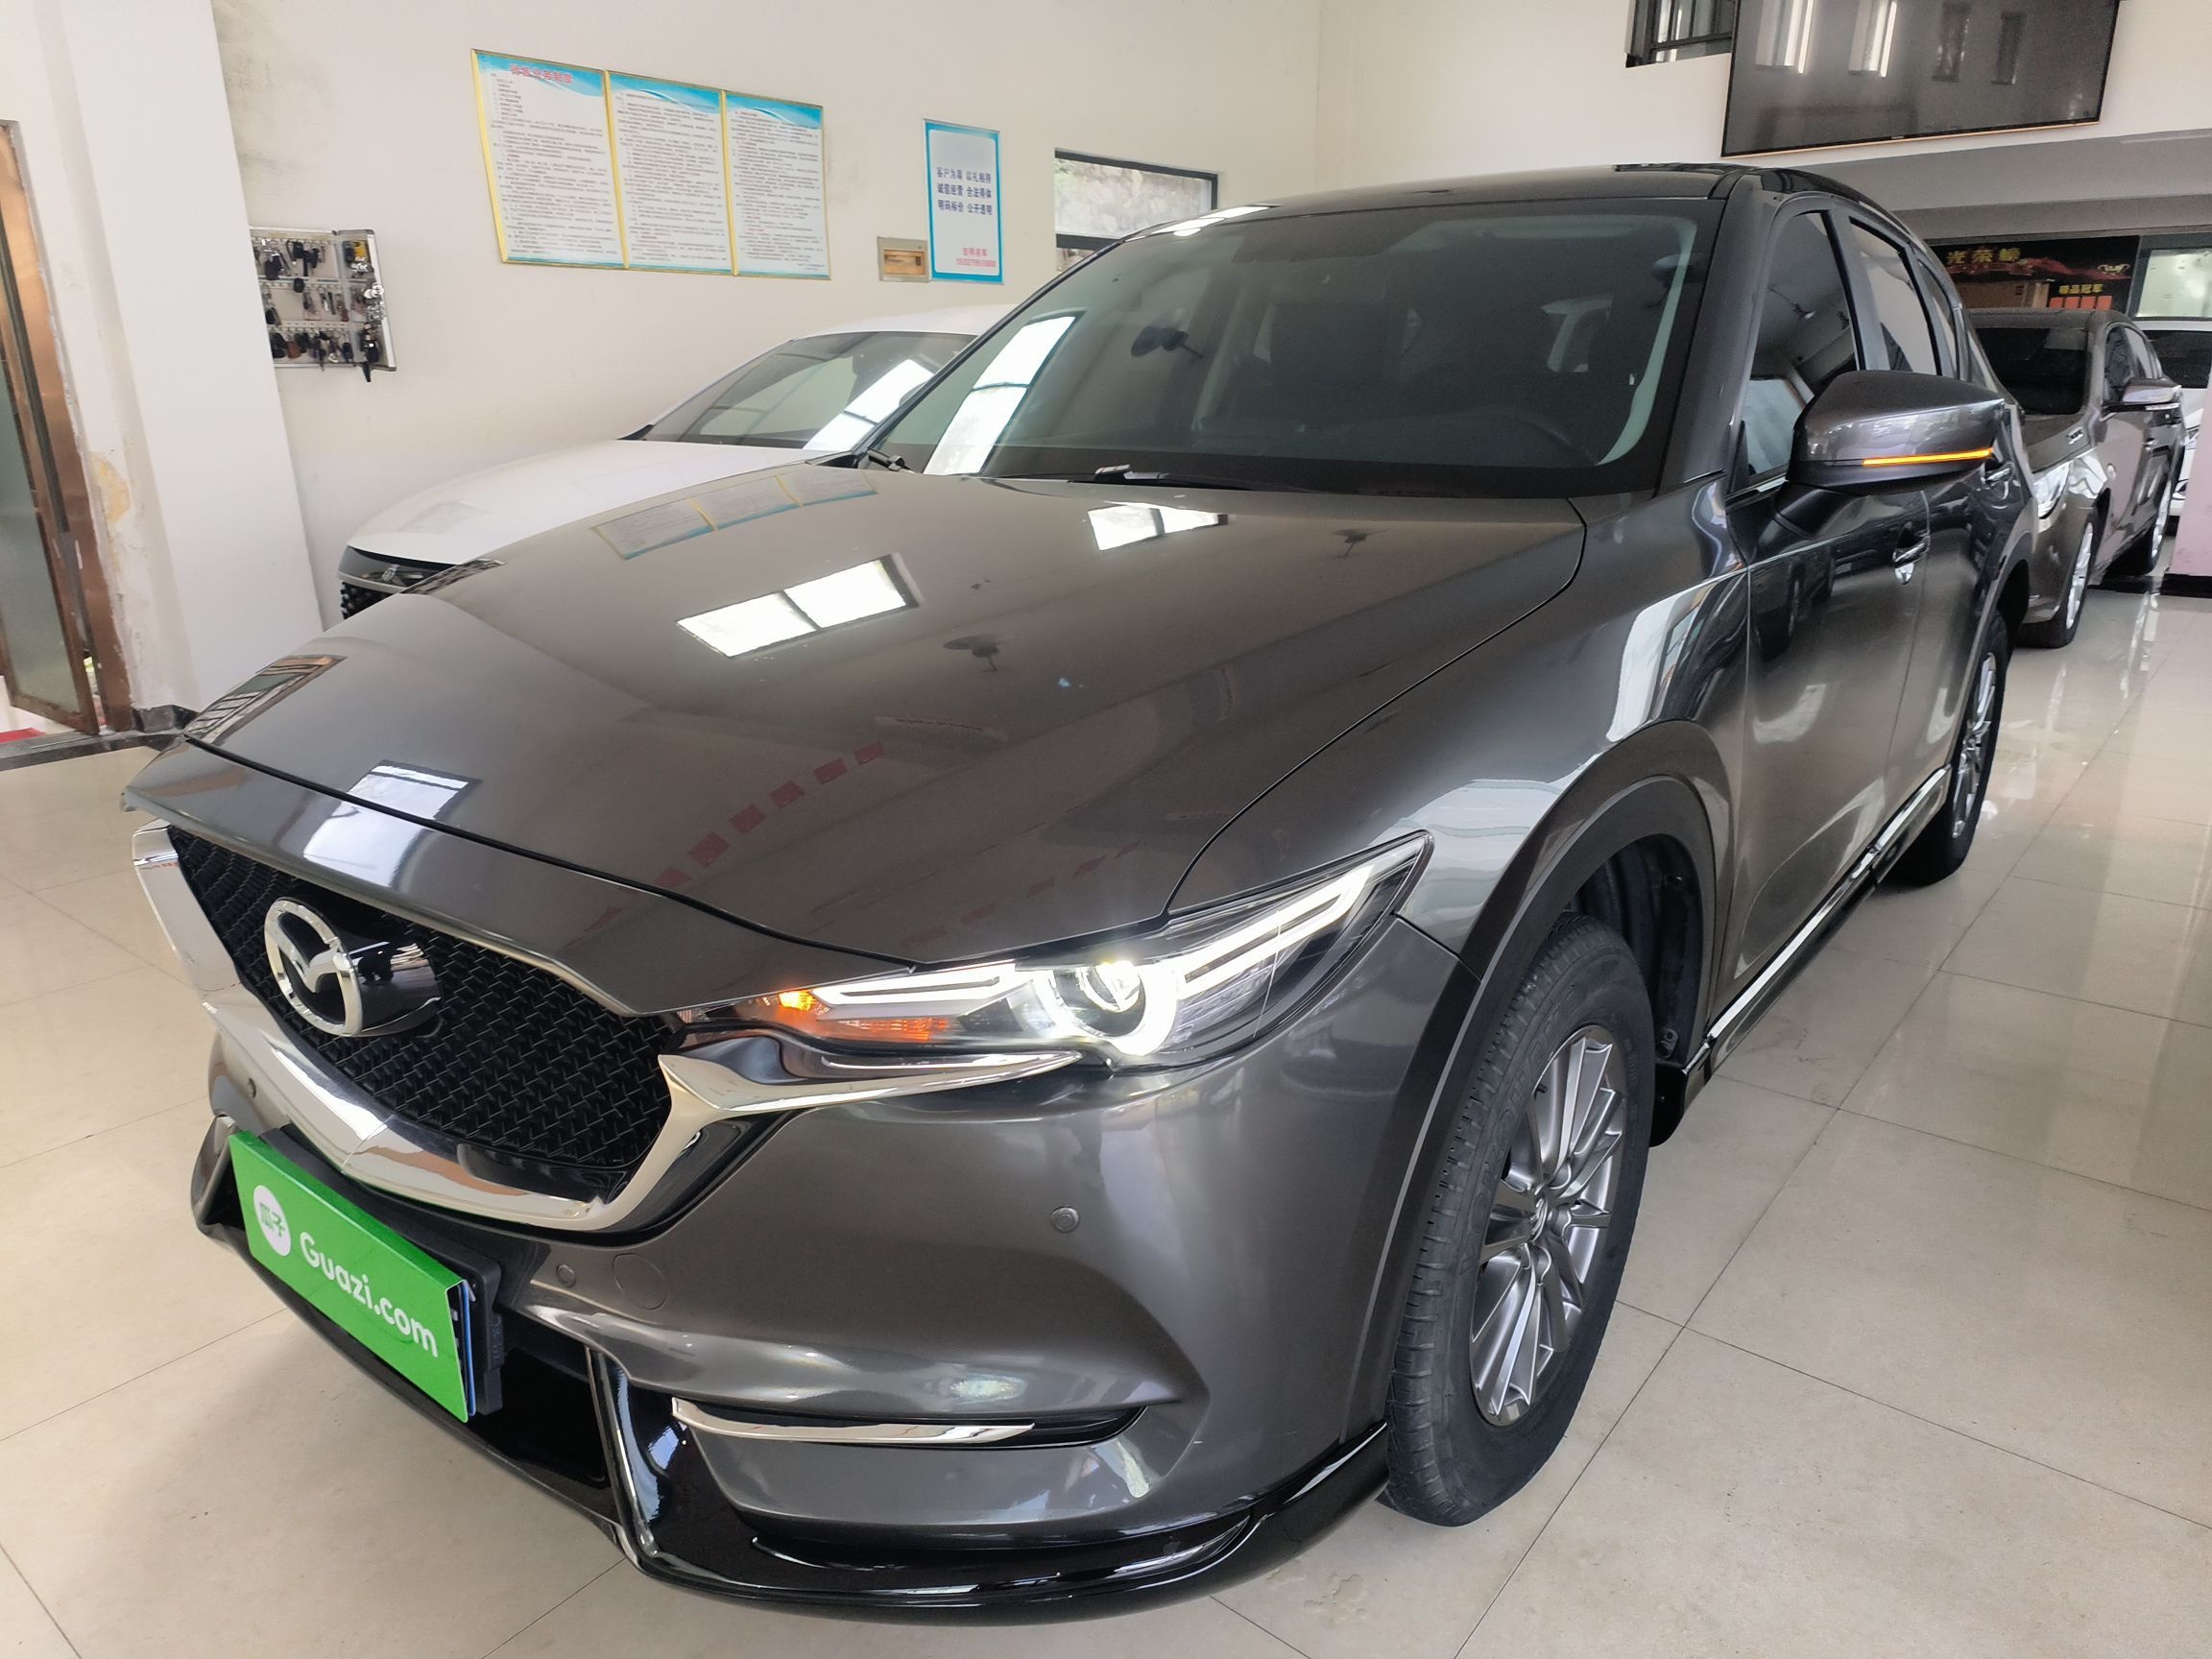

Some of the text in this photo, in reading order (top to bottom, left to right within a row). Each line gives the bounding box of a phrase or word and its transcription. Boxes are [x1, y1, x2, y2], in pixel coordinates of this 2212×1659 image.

[937, 183, 964, 196] 诚信经营
[938, 200, 993, 215] 明码标价 公开透明
[259, 1202, 285, 1238] 瓜子
[300, 1231, 439, 1358] Guazi.com
